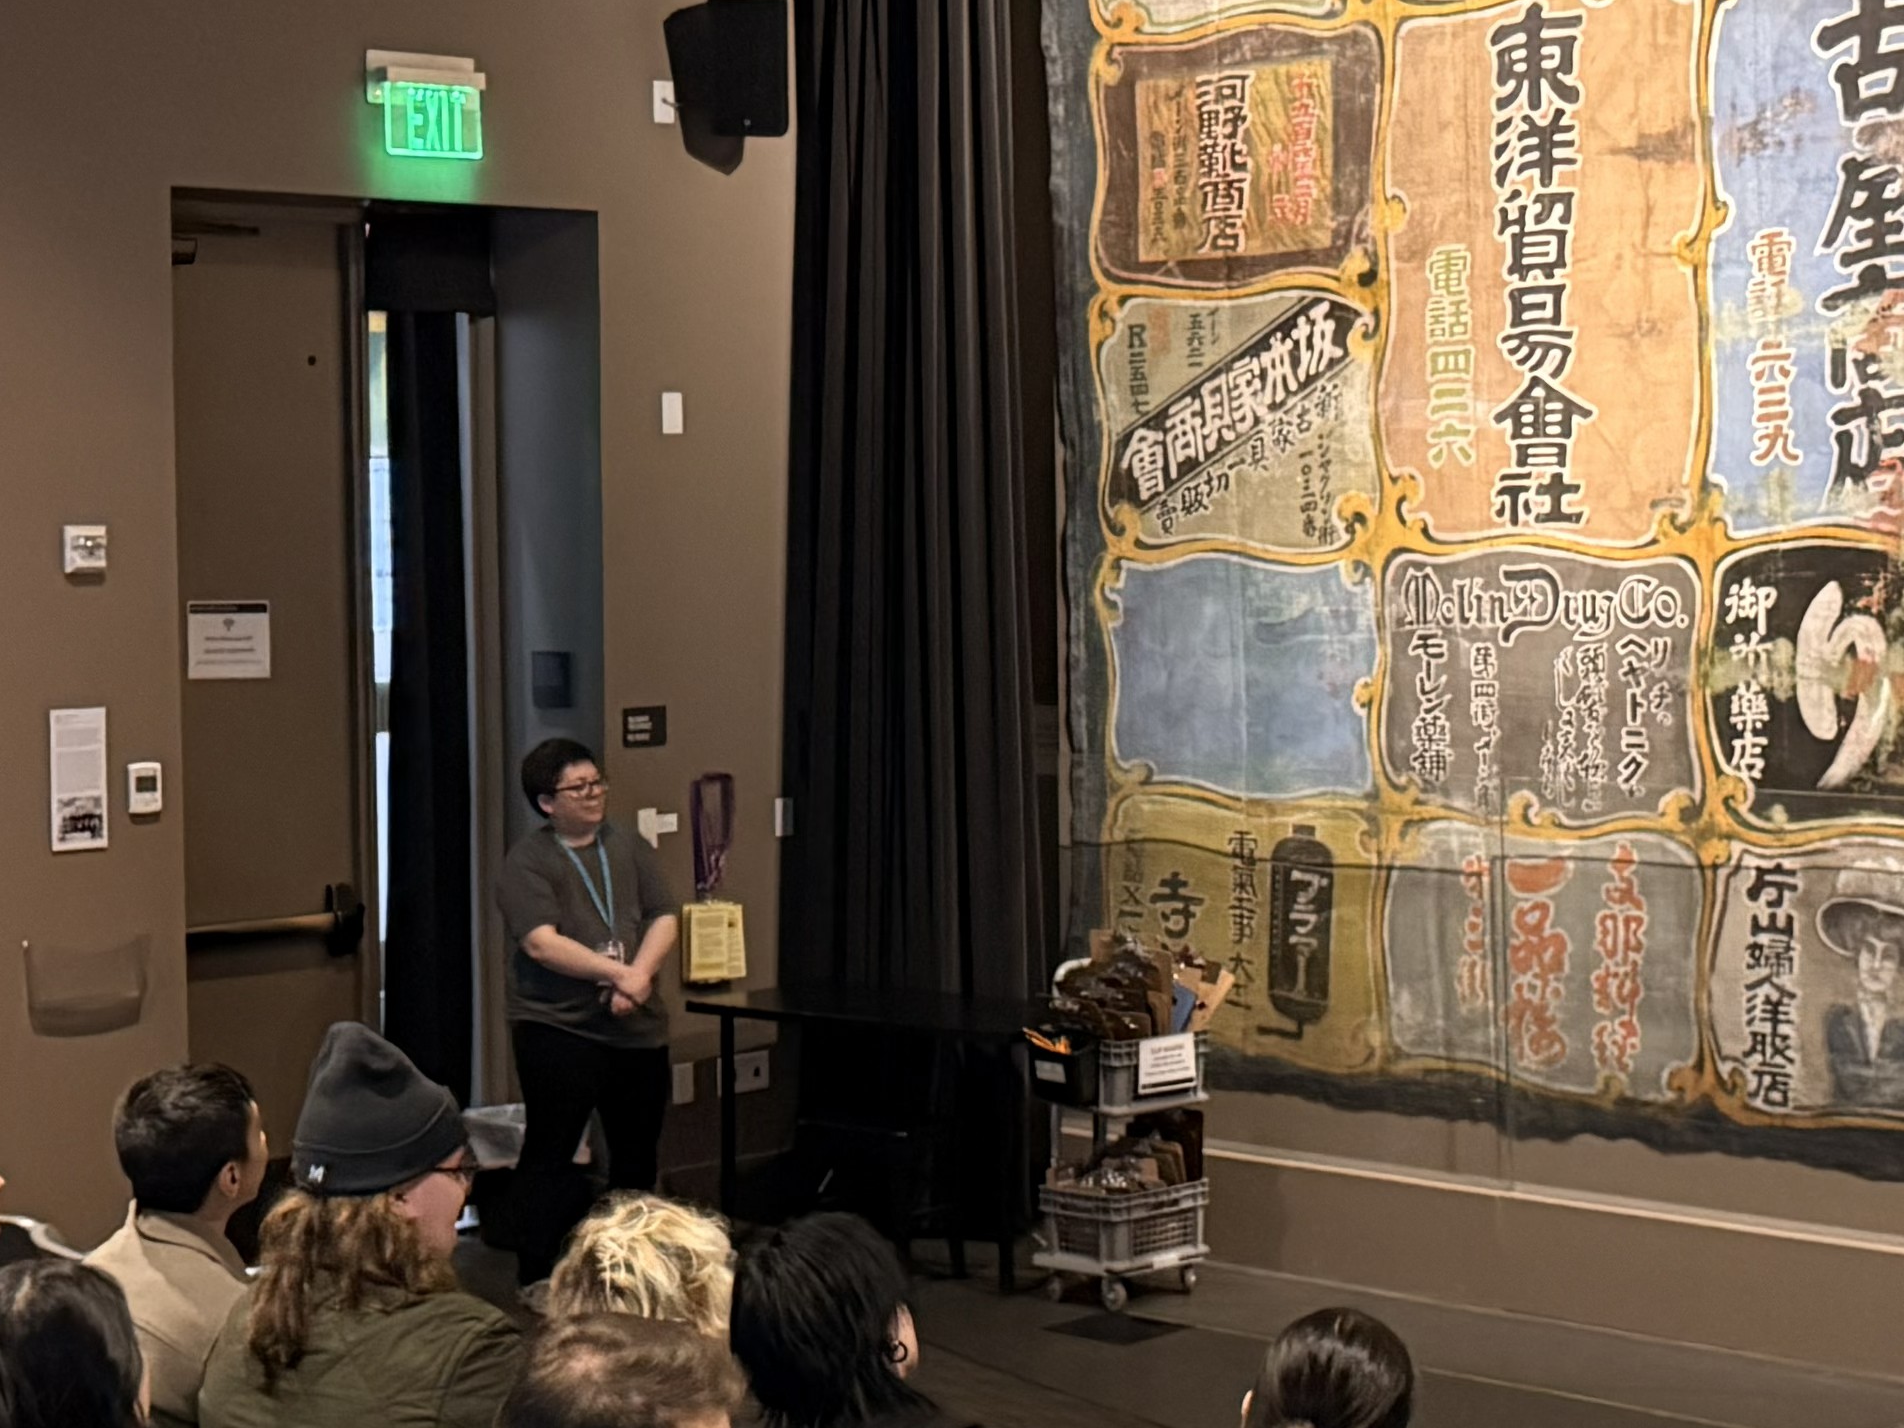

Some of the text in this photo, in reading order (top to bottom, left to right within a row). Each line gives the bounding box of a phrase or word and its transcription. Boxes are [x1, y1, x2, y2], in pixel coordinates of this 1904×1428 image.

[406, 87, 466, 152] EXIT
[1487, 0, 1598, 529] 東洋貿易會社
[1498, 562, 1616, 648] Drug
